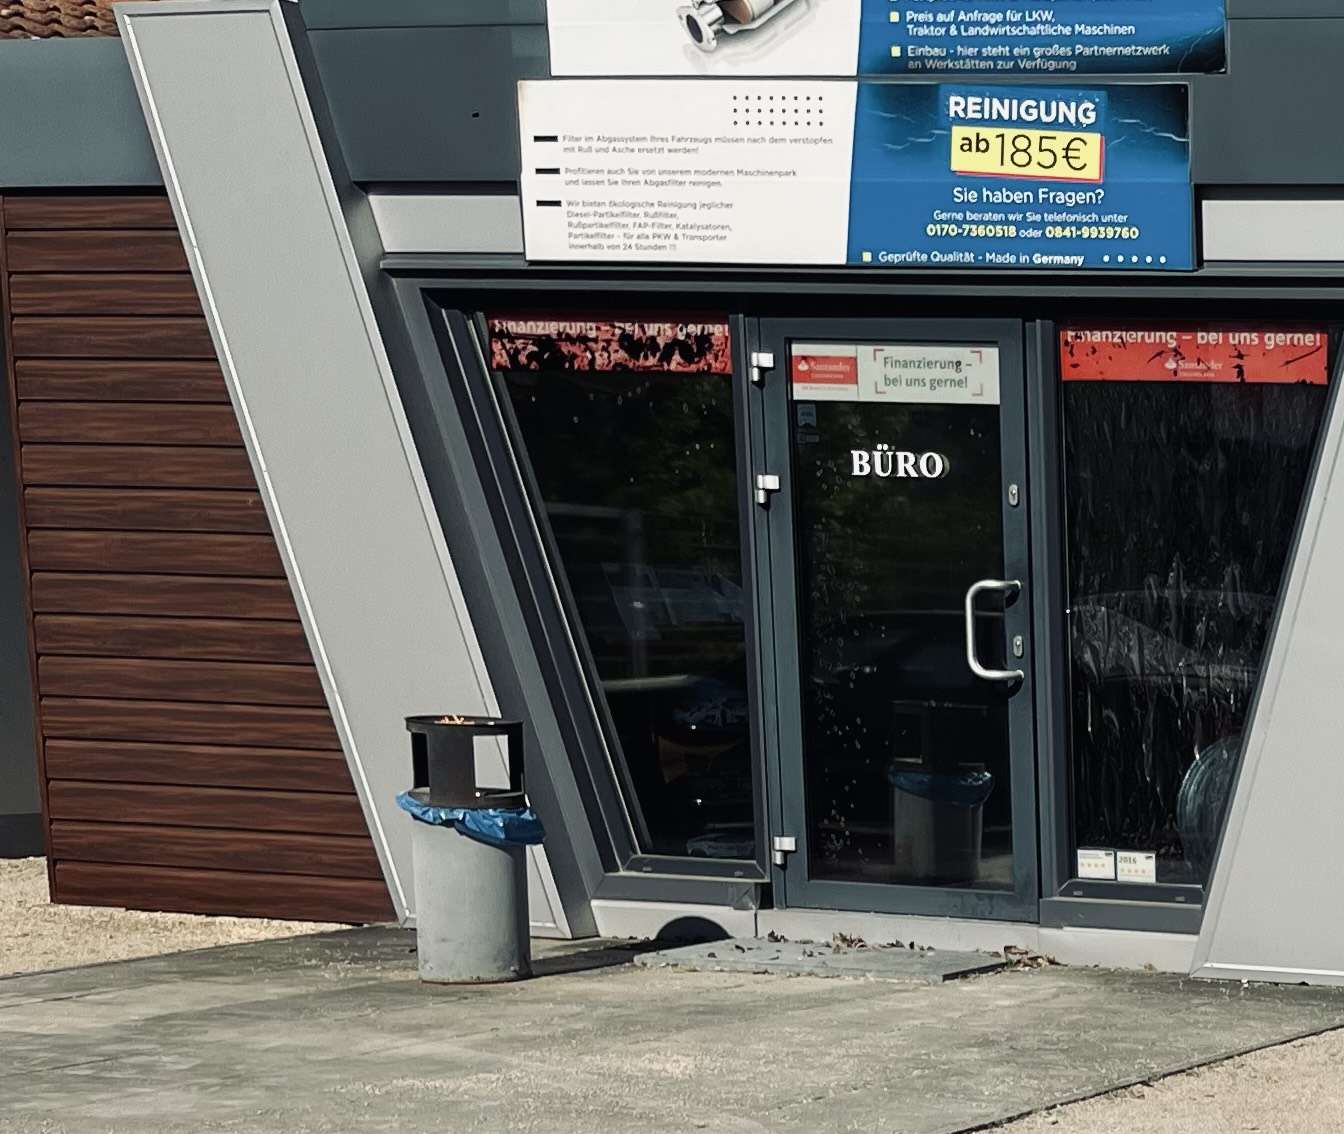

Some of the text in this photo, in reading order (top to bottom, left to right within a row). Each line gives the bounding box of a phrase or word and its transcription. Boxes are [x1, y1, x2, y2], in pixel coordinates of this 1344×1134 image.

[905, 10, 1055, 24] Preis auf Anfrage für LKW,
[907, 24, 1135, 36] Traktor & Landwirtschaftliche Maschinen
[907, 45, 946, 57] Einbau
[957, 45, 978, 57] hier
[981, 45, 1009, 57] steht
[1013, 45, 1030, 57] ein
[1034, 44, 1072, 58] großes
[1075, 44, 1169, 57] Partnernetzwerk
[908, 58, 1077, 71] an Werkstätten zur Verfügung
[949, 95, 1097, 125] REINIGUNG
[597, 136, 647, 144] Abgassystem
[671, 136, 712, 144] Fahrzeugs
[714, 136, 745, 144] müssen
[789, 137, 833, 145] verstopfen
[959, 133, 1088, 171] ab 185€
[736, 169, 797, 177] Maschinenpark
[643, 179, 686, 187] Abgasfilter
[953, 187, 1105, 207] Sie haben Fragen?
[657, 202, 697, 210] Reinigung
[933, 211, 1128, 223] Gerne beraten wir Sie telefonisch unter
[682, 233, 727, 241] Transporter
[926, 224, 1139, 240] 0170-7360518 oder 0841-9939760
[635, 243, 667, 251] Stunden
[878, 251, 928, 264] Geprüfte
[930, 252, 975, 265] Qualität
[985, 253, 1017, 263] Made
[1020, 253, 1030, 263] in
[1032, 253, 1085, 266] Germany
[1229, 332, 1260, 345] uns
[883, 356, 963, 373] Finanzierung
[883, 374, 968, 391] bei uns gerne!
[851, 443, 945, 478] BÜRO
